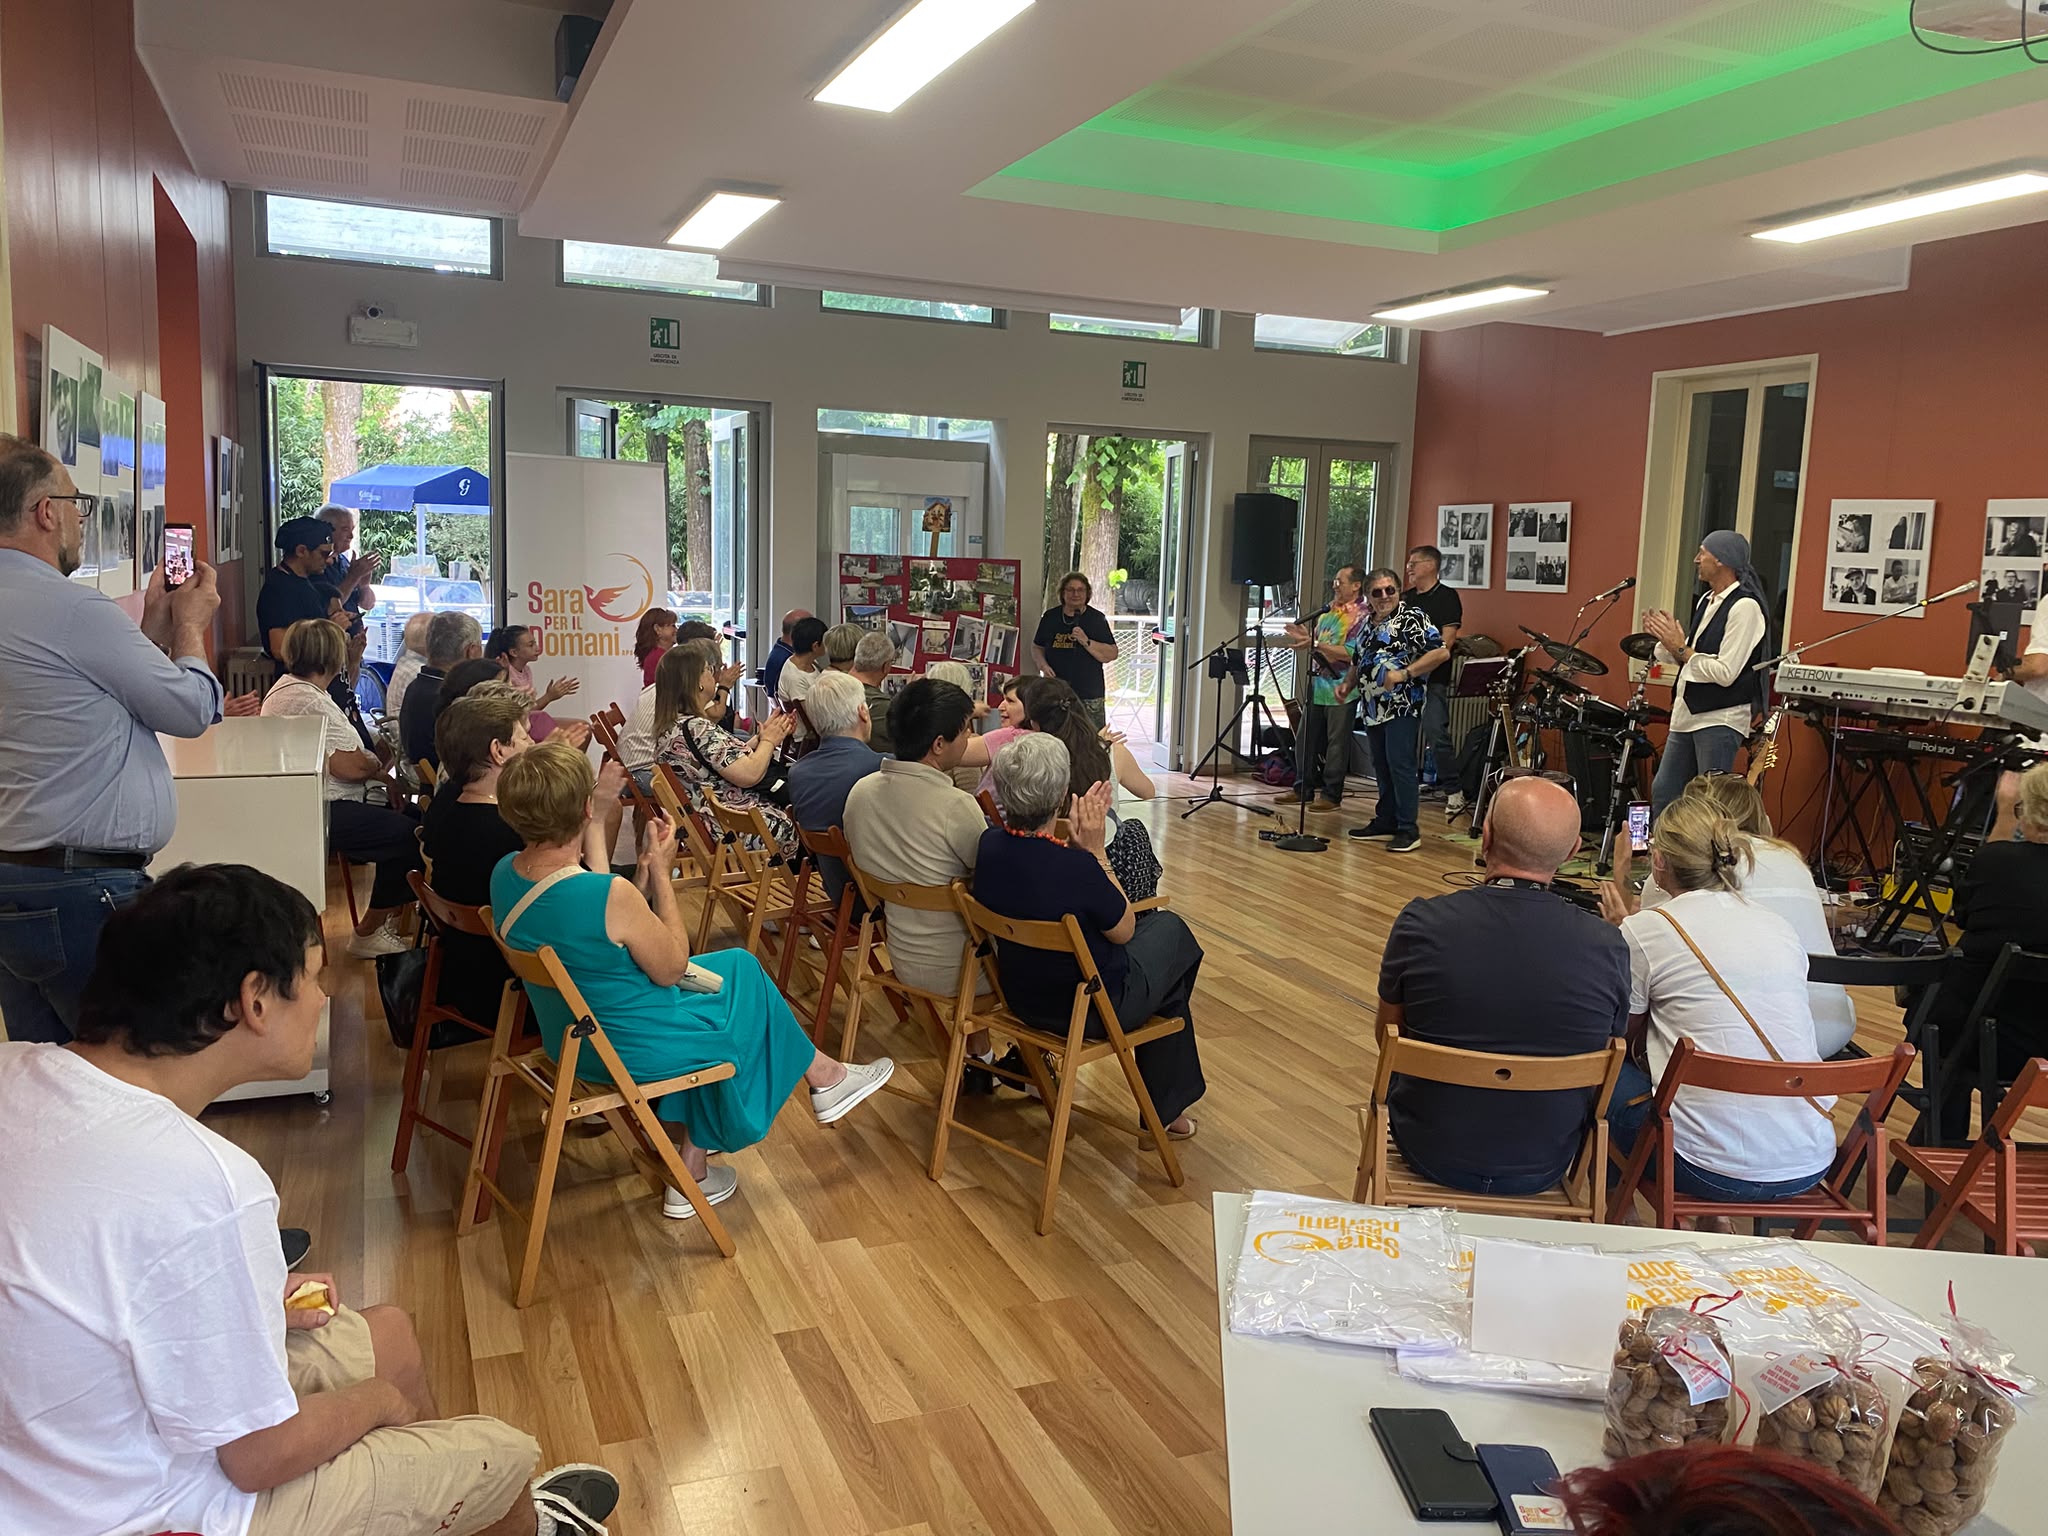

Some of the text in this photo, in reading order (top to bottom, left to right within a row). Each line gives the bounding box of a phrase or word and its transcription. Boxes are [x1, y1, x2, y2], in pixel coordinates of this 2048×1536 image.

[528, 581, 584, 614] Sara
[544, 616, 583, 631] PER IL
[1786, 667, 1833, 682] KETRON
[1920, 742, 1956, 755] Roland
[1337, 1235, 1400, 1260] Sara
